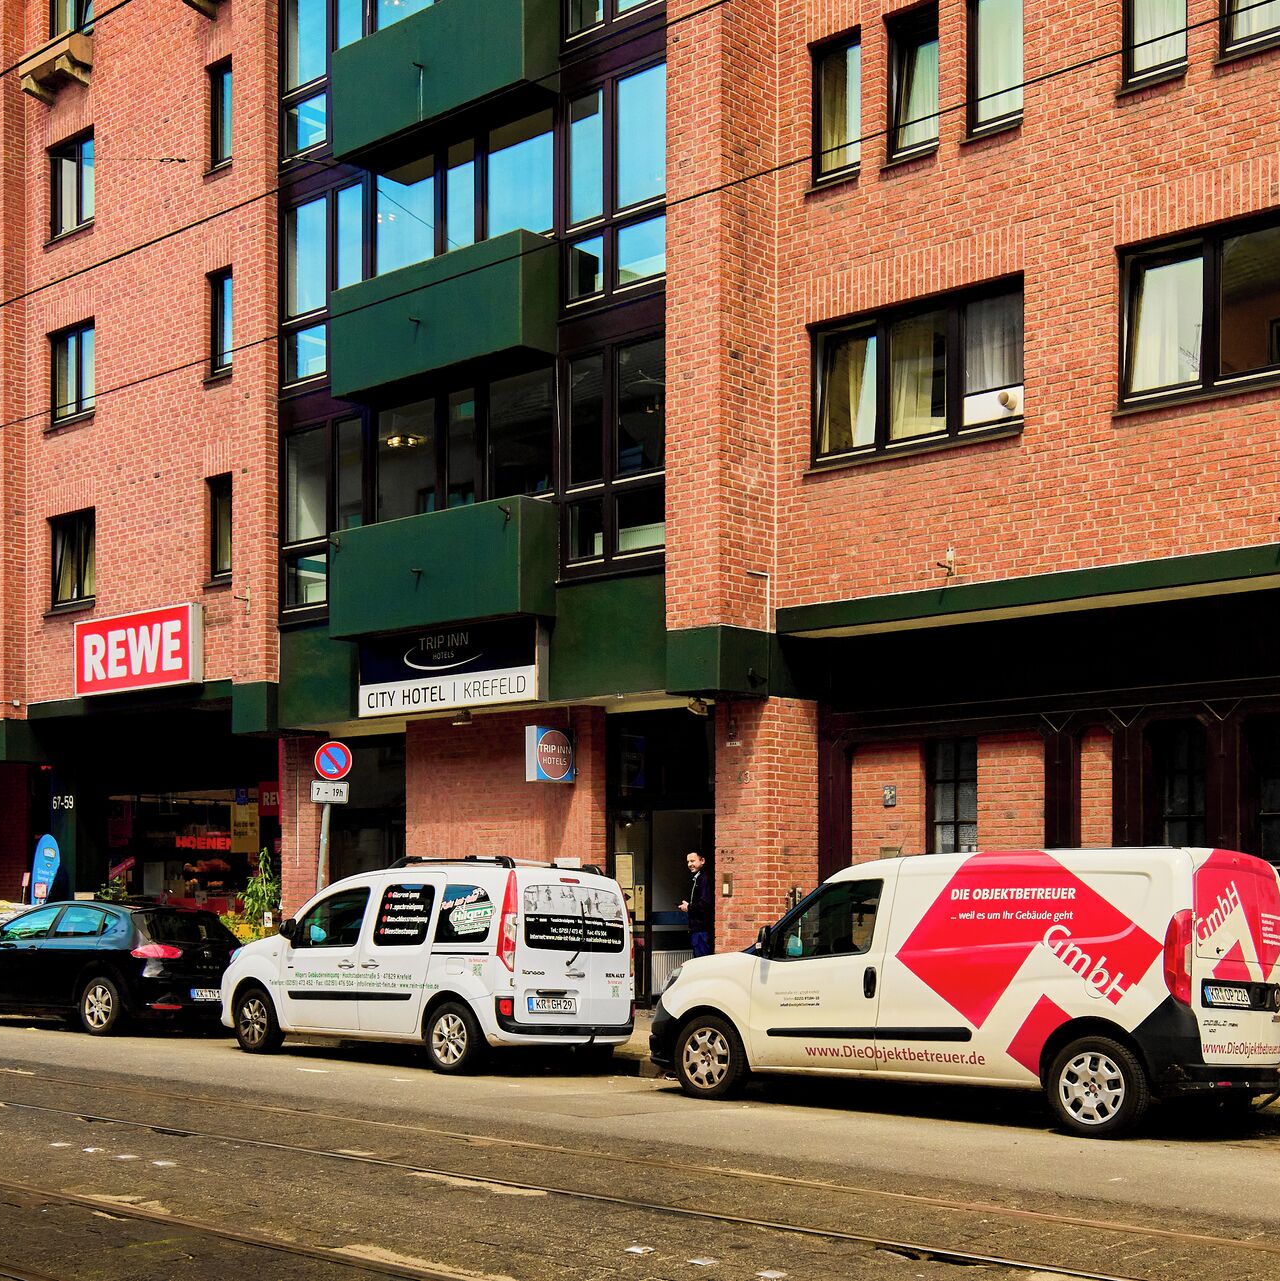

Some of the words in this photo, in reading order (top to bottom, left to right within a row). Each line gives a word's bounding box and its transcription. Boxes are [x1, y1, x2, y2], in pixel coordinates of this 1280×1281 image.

[419, 636, 445, 651] TRIP
[447, 632, 469, 647] INN
[82, 619, 183, 683] REWE
[432, 650, 455, 660] HOTELS
[366, 690, 396, 709] CITY
[402, 685, 446, 706] HOTEL
[464, 675, 527, 699] KREFELD
[538, 743, 556, 753] TRIP
[557, 745, 572, 754] INN
[542, 757, 568, 766] HOTELS
[736, 770, 750, 784] 63
[316, 788, 321, 796] 7
[332, 788, 344, 797] 19h
[52, 795, 74, 810] 67-59
[951, 888, 970, 900] DIE
[972, 887, 1076, 900] OBJEKTBETREUER
[958, 911, 975, 920] weil
[1002, 911, 1015, 920] Ihr
[1015, 910, 1052, 920] Gebäude
[1054, 911, 1074, 922] geht
[1196, 880, 1241, 940] GmbH
[1043, 924, 1138, 1006] GmbH
[1209, 988, 1222, 1000] KR
[536, 999, 546, 1009] KR
[551, 1000, 562, 1009] GH
[564, 1000, 572, 1010] 29
[805, 1045, 985, 1065] www.DieObjektbetreuer.de
